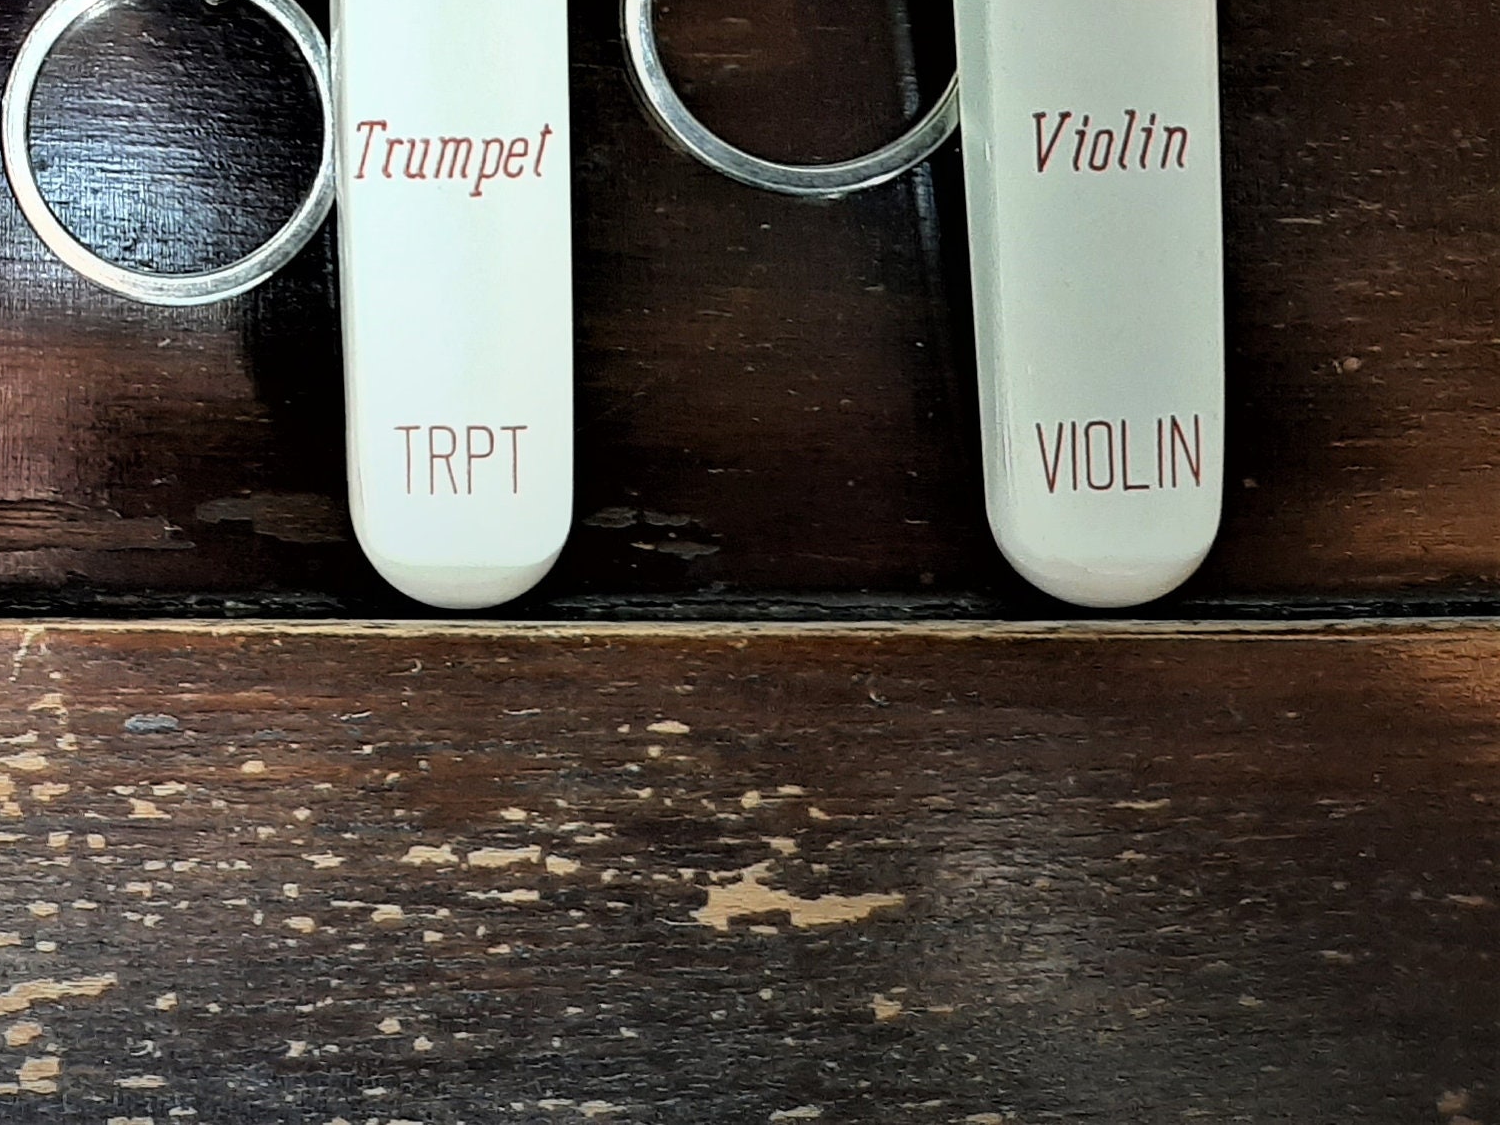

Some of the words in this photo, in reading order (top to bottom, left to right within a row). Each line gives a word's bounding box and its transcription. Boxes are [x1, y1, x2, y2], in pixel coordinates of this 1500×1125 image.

[353, 119, 553, 198] Trumpet
[1032, 109, 1189, 173] Violin
[394, 425, 529, 496] TRPT
[1035, 413, 1201, 494] VIOLIN
